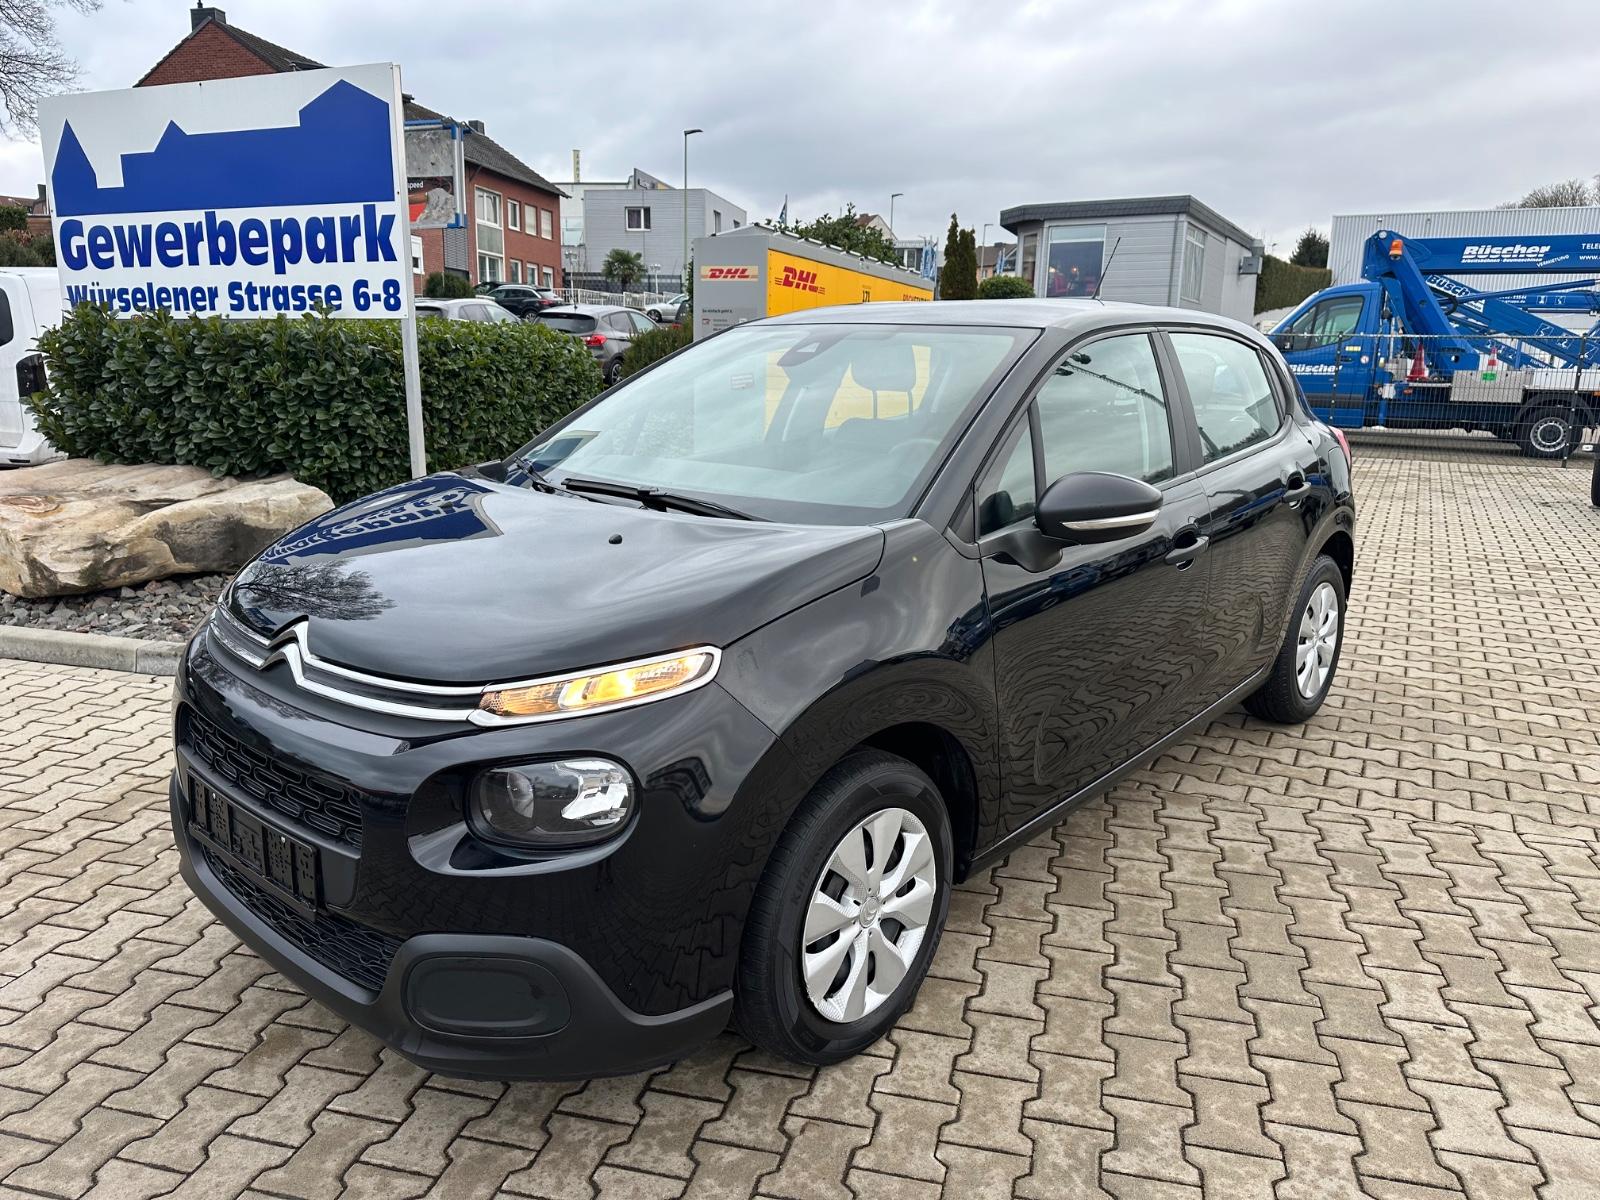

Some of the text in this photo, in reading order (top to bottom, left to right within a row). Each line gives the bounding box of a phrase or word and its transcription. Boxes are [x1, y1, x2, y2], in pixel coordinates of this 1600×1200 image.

[59, 204, 397, 275] Gewerbepark
[1462, 244, 1551, 259] Büscher
[708, 268, 750, 279] DHL
[782, 265, 819, 293] DHL
[66, 279, 402, 312] Würselener Strasse 6-8
